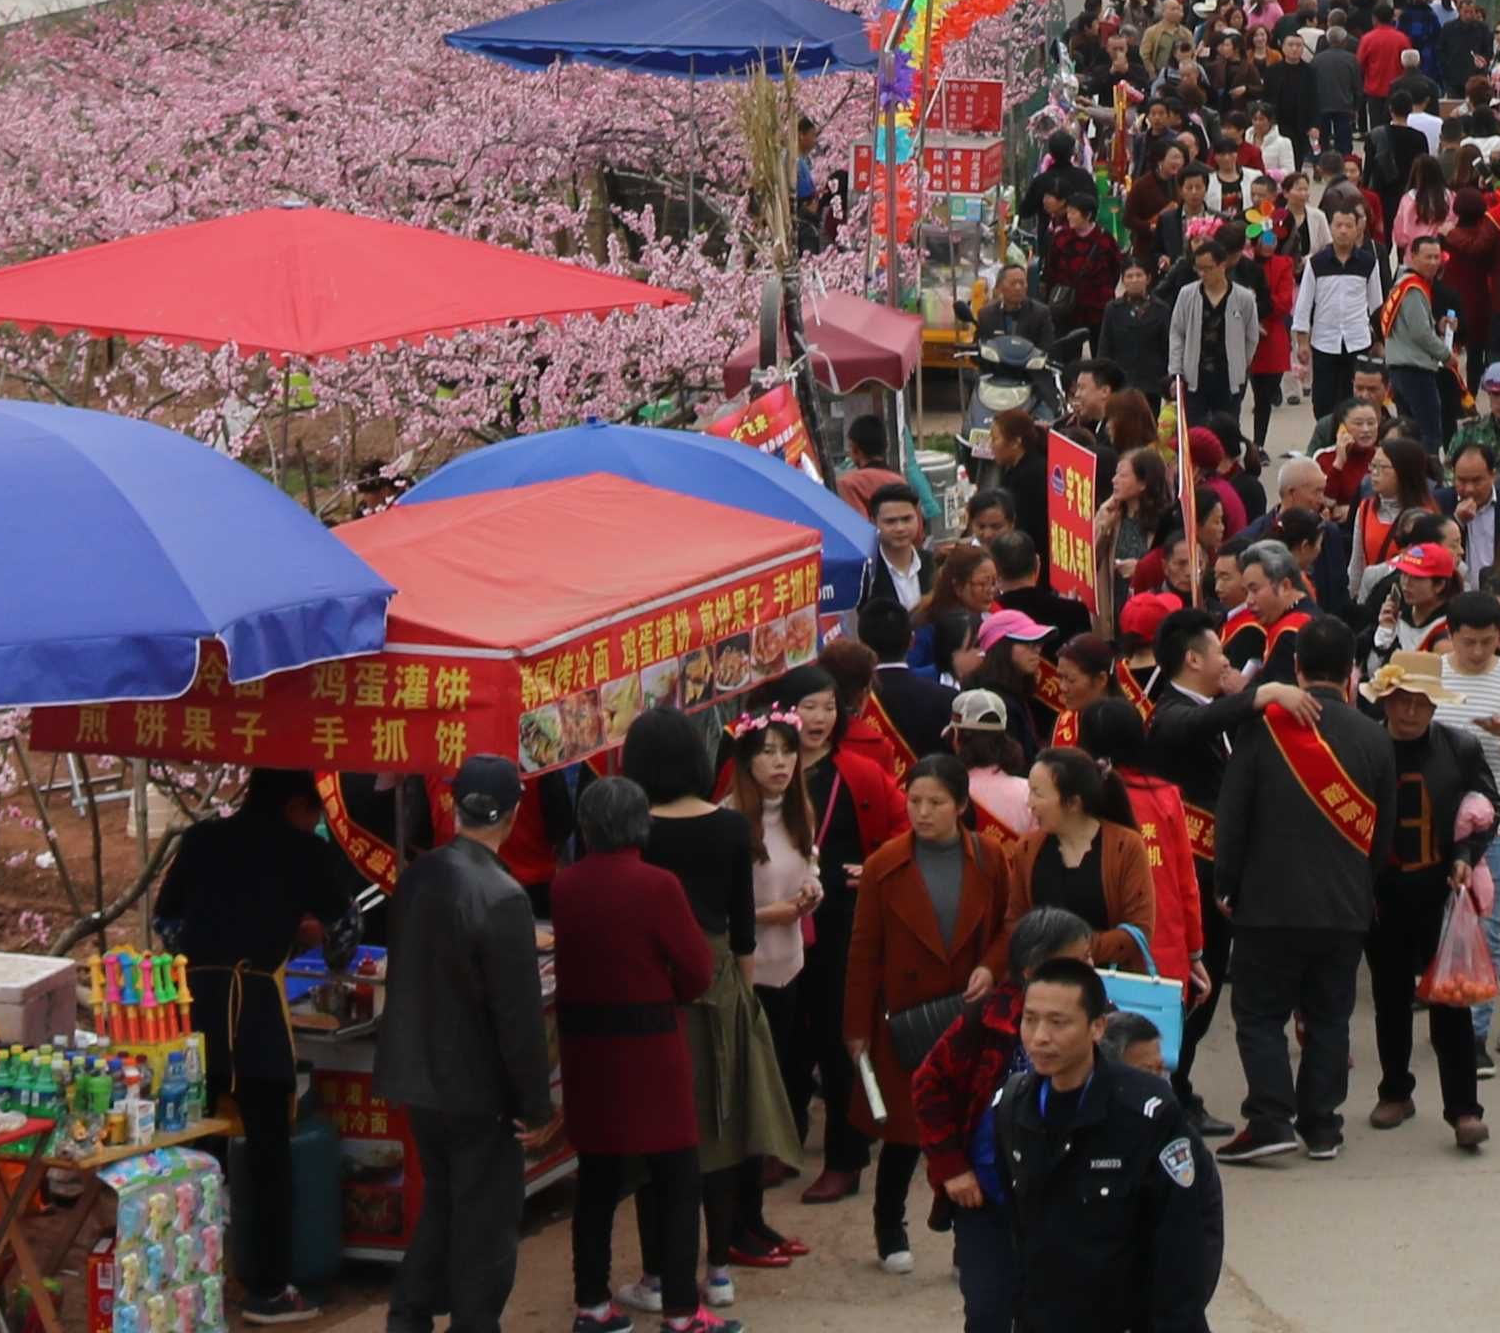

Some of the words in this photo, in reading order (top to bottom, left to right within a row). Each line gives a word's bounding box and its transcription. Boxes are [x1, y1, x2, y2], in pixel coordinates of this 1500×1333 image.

[519, 638, 611, 709] 韩国烤冷面
[621, 609, 692, 671] 鸡蛋灌饼
[699, 584, 765, 645] 煎饼果子
[772, 561, 819, 616] 手抓饼
[311, 660, 471, 713] 鸡蛋灌饼
[76, 703, 268, 755] 煎饼果子
[311, 715, 467, 769] 手抓饼
